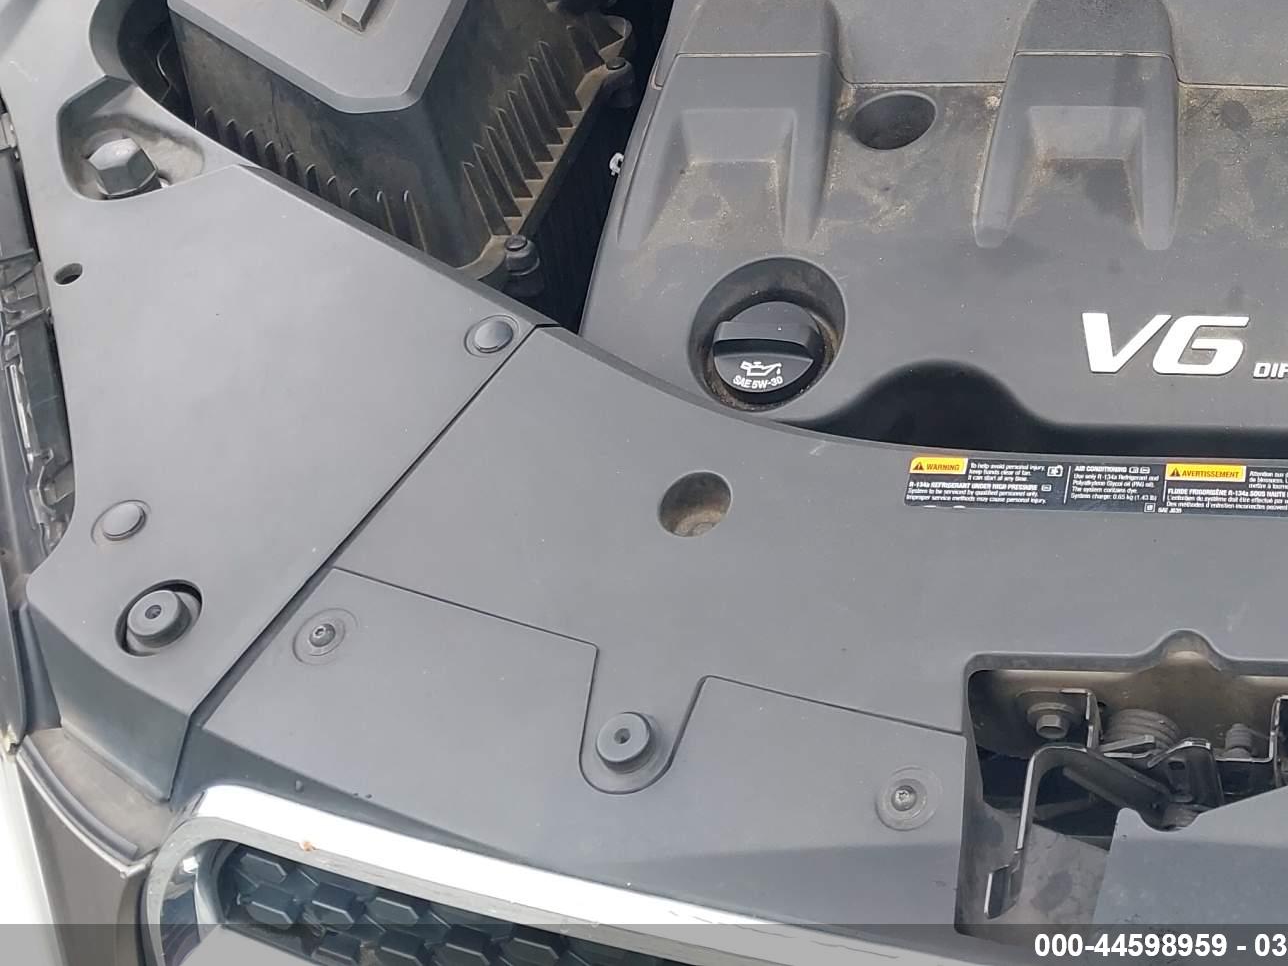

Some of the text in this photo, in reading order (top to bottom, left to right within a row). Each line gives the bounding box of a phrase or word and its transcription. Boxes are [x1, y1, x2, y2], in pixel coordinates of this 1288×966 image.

[1082, 313, 1249, 377] V6
[733, 375, 783, 389] SAE 5W-30
